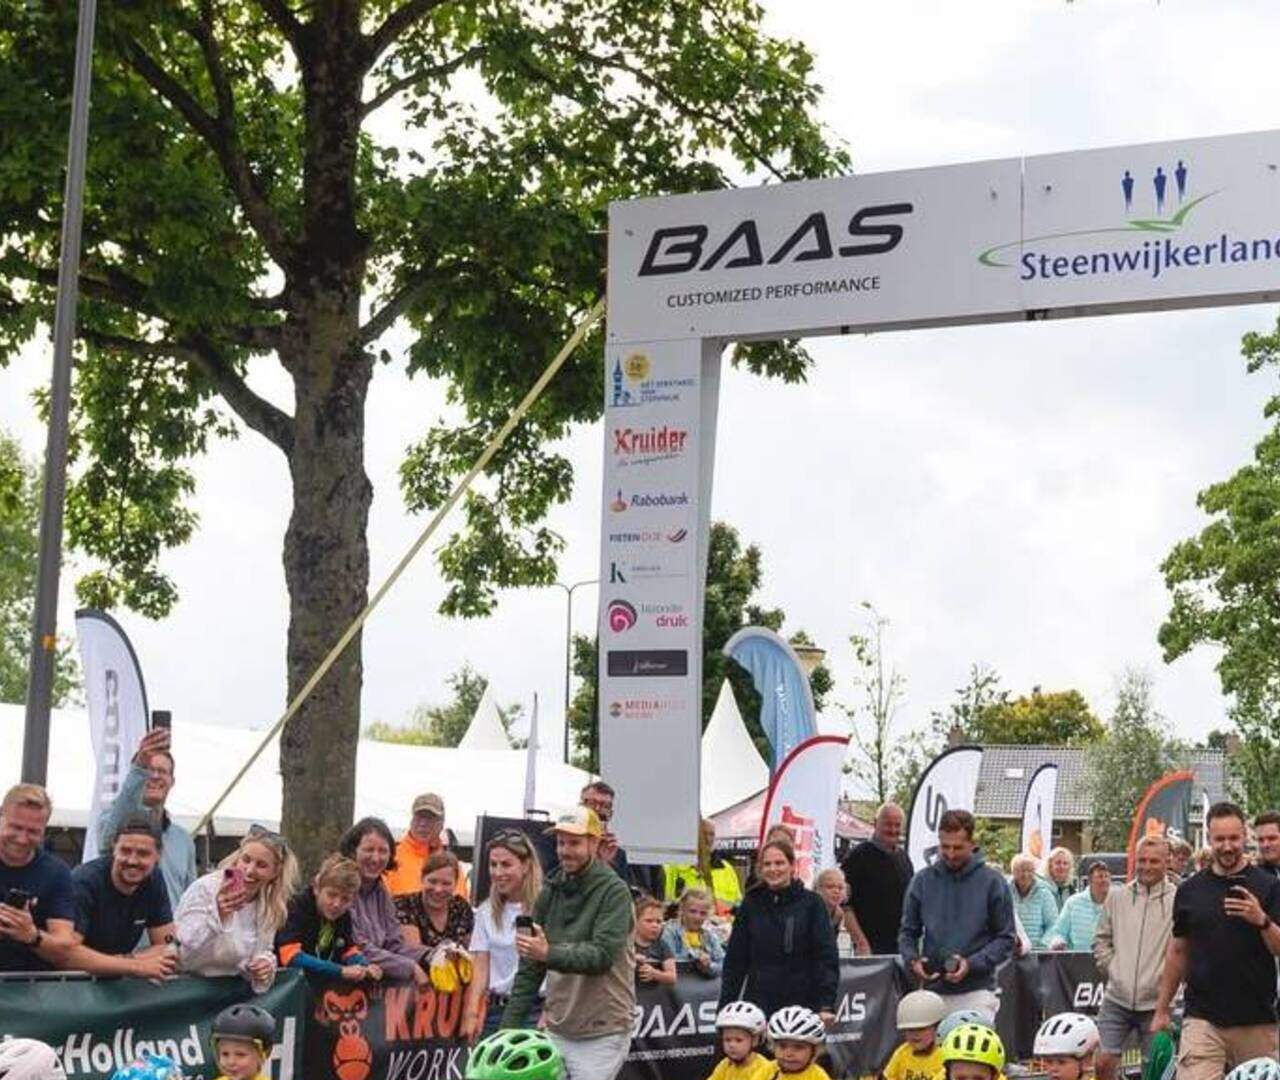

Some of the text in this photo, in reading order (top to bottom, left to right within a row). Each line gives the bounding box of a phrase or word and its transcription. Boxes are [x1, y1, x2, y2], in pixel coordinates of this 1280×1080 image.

[637, 202, 915, 278] BAAS
[666, 274, 882, 309] CUSTOMIZED PERFORMANCE
[613, 424, 688, 455] Kruider
[630, 490, 689, 507] Rabobank
[655, 614, 689, 628] druk
